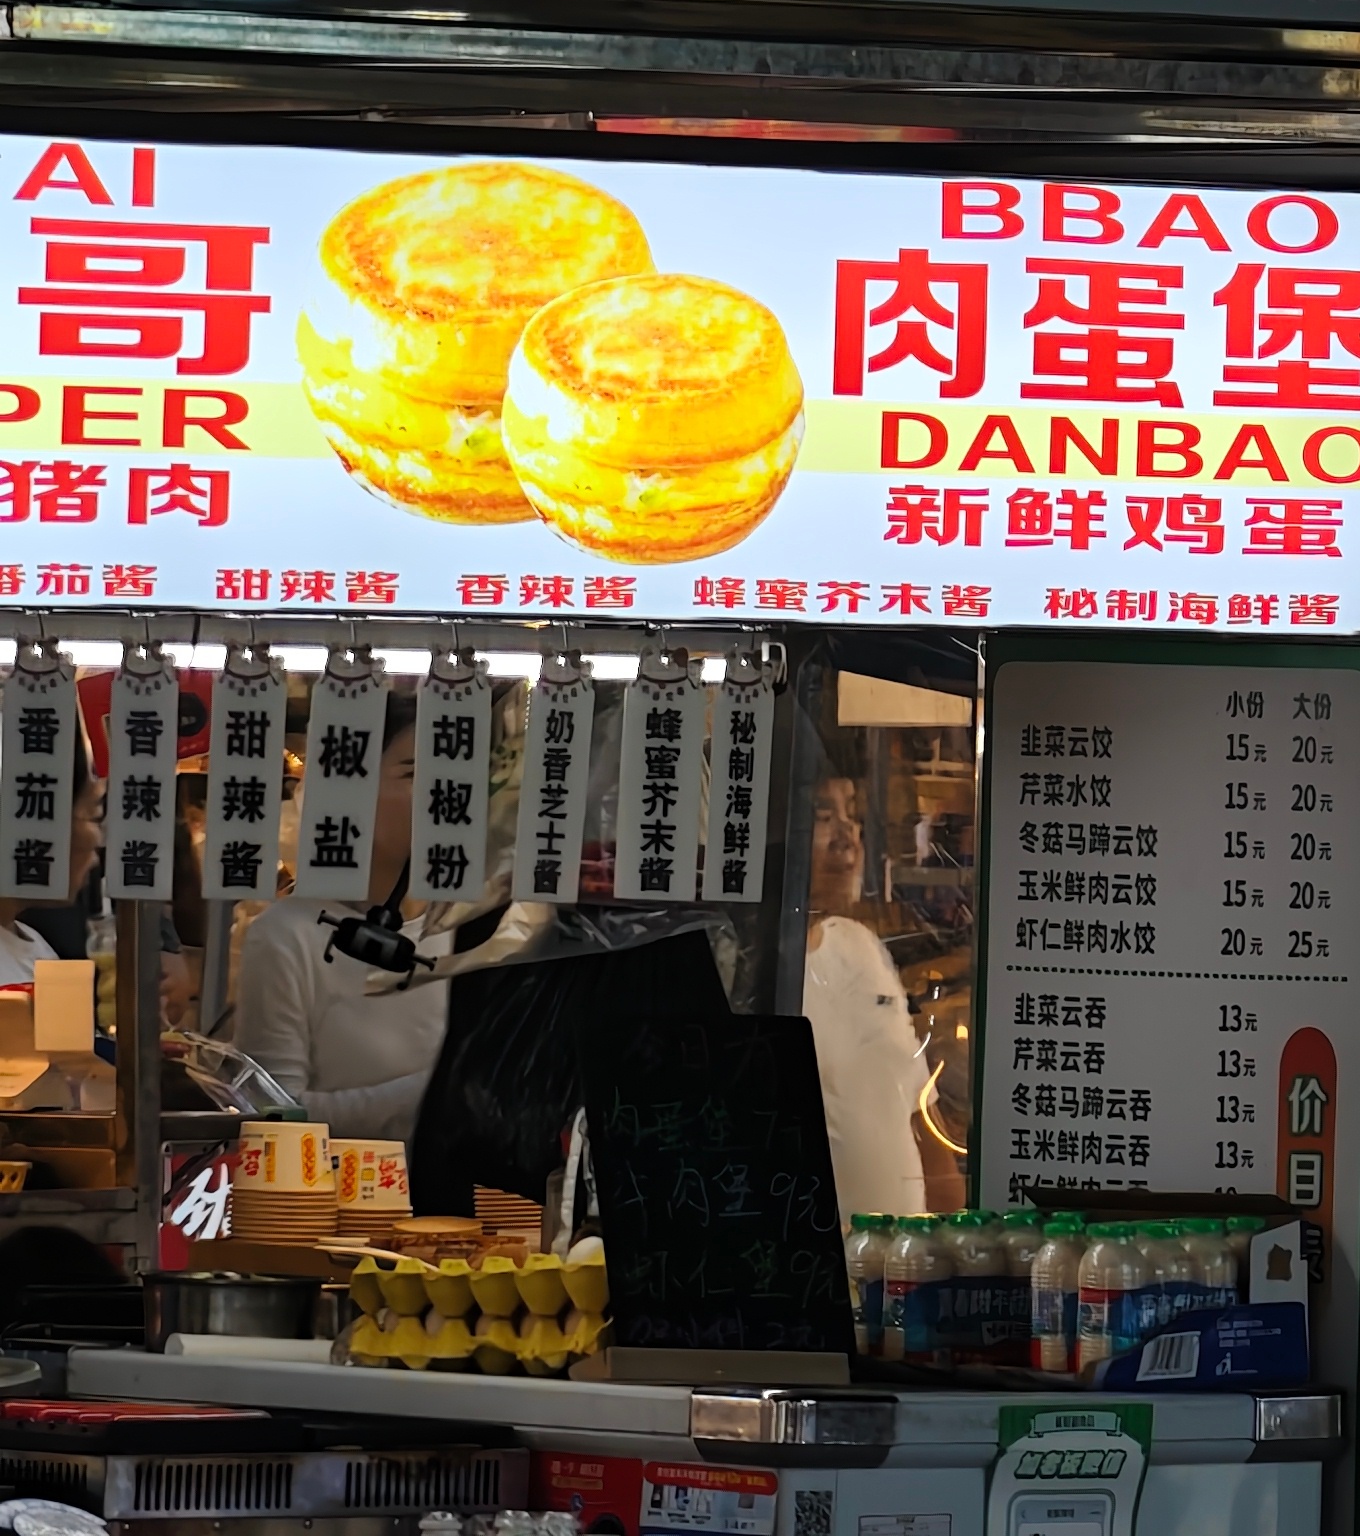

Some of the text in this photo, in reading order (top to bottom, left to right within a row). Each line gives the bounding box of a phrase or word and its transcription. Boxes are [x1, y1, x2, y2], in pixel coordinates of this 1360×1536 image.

[13, 142, 155, 207] AI
[942, 181, 1339, 253] BBAO
[18, 217, 271, 376] 哥
[0, 461, 230, 527] 猪肉
[883, 485, 1343, 557] 新鲜鸡蛋
[217, 569, 400, 605] 甜辣酱
[456, 574, 637, 609] 香辣酱
[693, 577, 992, 619] 蜂蜜芥末酱
[1044, 587, 1340, 625] 秘制海鲜酱
[1226, 691, 1332, 720] 小份 大份
[1020, 725, 1334, 764] 韭菜云饺 15元 20元
[14, 708, 60, 886] 番茄酱
[121, 711, 165, 888] 香辣酱
[221, 710, 270, 889] 甜辣酱
[310, 725, 368, 869] 椒盐
[427, 715, 476, 890] 胡椒粉
[533, 709, 575, 895] 奶香芝士酱
[639, 707, 682, 893] 蜂蜜芥末酱
[722, 710, 757, 895] 秘制海鲜酱
[1019, 773, 1333, 813] 芹菜水饺 15元 20元
[1019, 821, 1333, 861] 冬菇马蹄云饺 15元 20元
[1018, 870, 1331, 910] 玉米鲜肉云饺 15元 20元
[1016, 918, 1330, 959] 虾仁鲜肉水饺 20元 25元
[1014, 993, 1258, 1032] 韭菜云吞 13元
[1013, 1037, 1256, 1078] 芹菜云吞 13元
[1011, 1083, 1255, 1123] 冬菇马蹄云吞 13元
[1010, 1129, 1254, 1169] 玉米鲜肉云吞 13元
